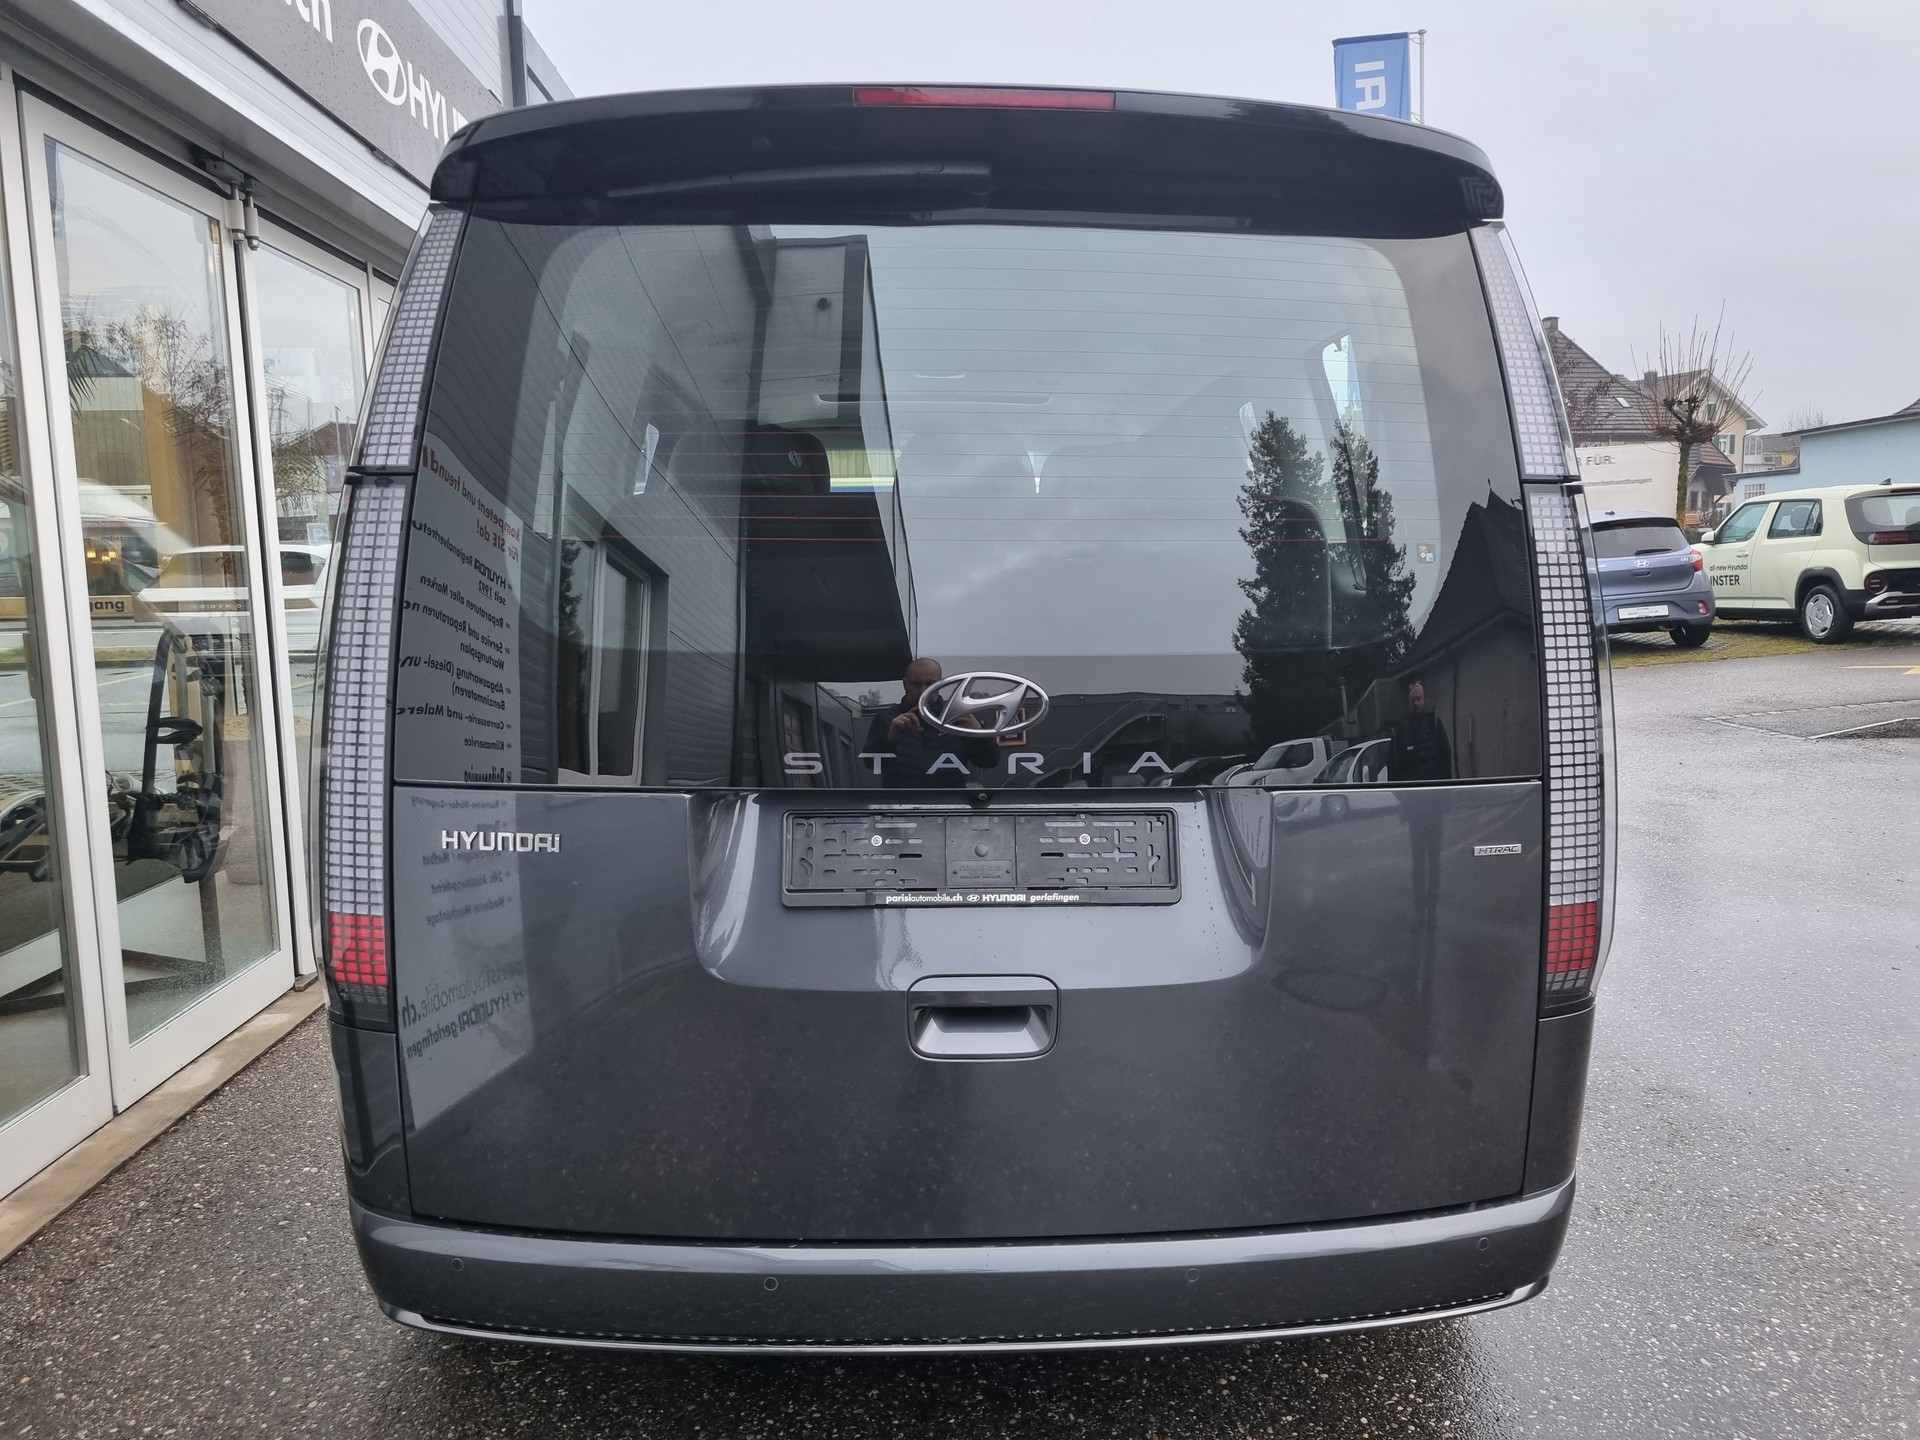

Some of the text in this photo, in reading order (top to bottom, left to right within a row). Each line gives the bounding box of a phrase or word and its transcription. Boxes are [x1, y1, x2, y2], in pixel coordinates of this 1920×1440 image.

[1727, 563, 1749, 571] Hyundai
[1710, 575, 1741, 586] INSTER
[783, 752, 1173, 775] STARIA
[441, 830, 562, 853] HYUNDAI
[1478, 845, 1519, 855] HTRAC
[886, 893, 1080, 904] parisiautomobile.ch HYUNDAI gerlafingen
